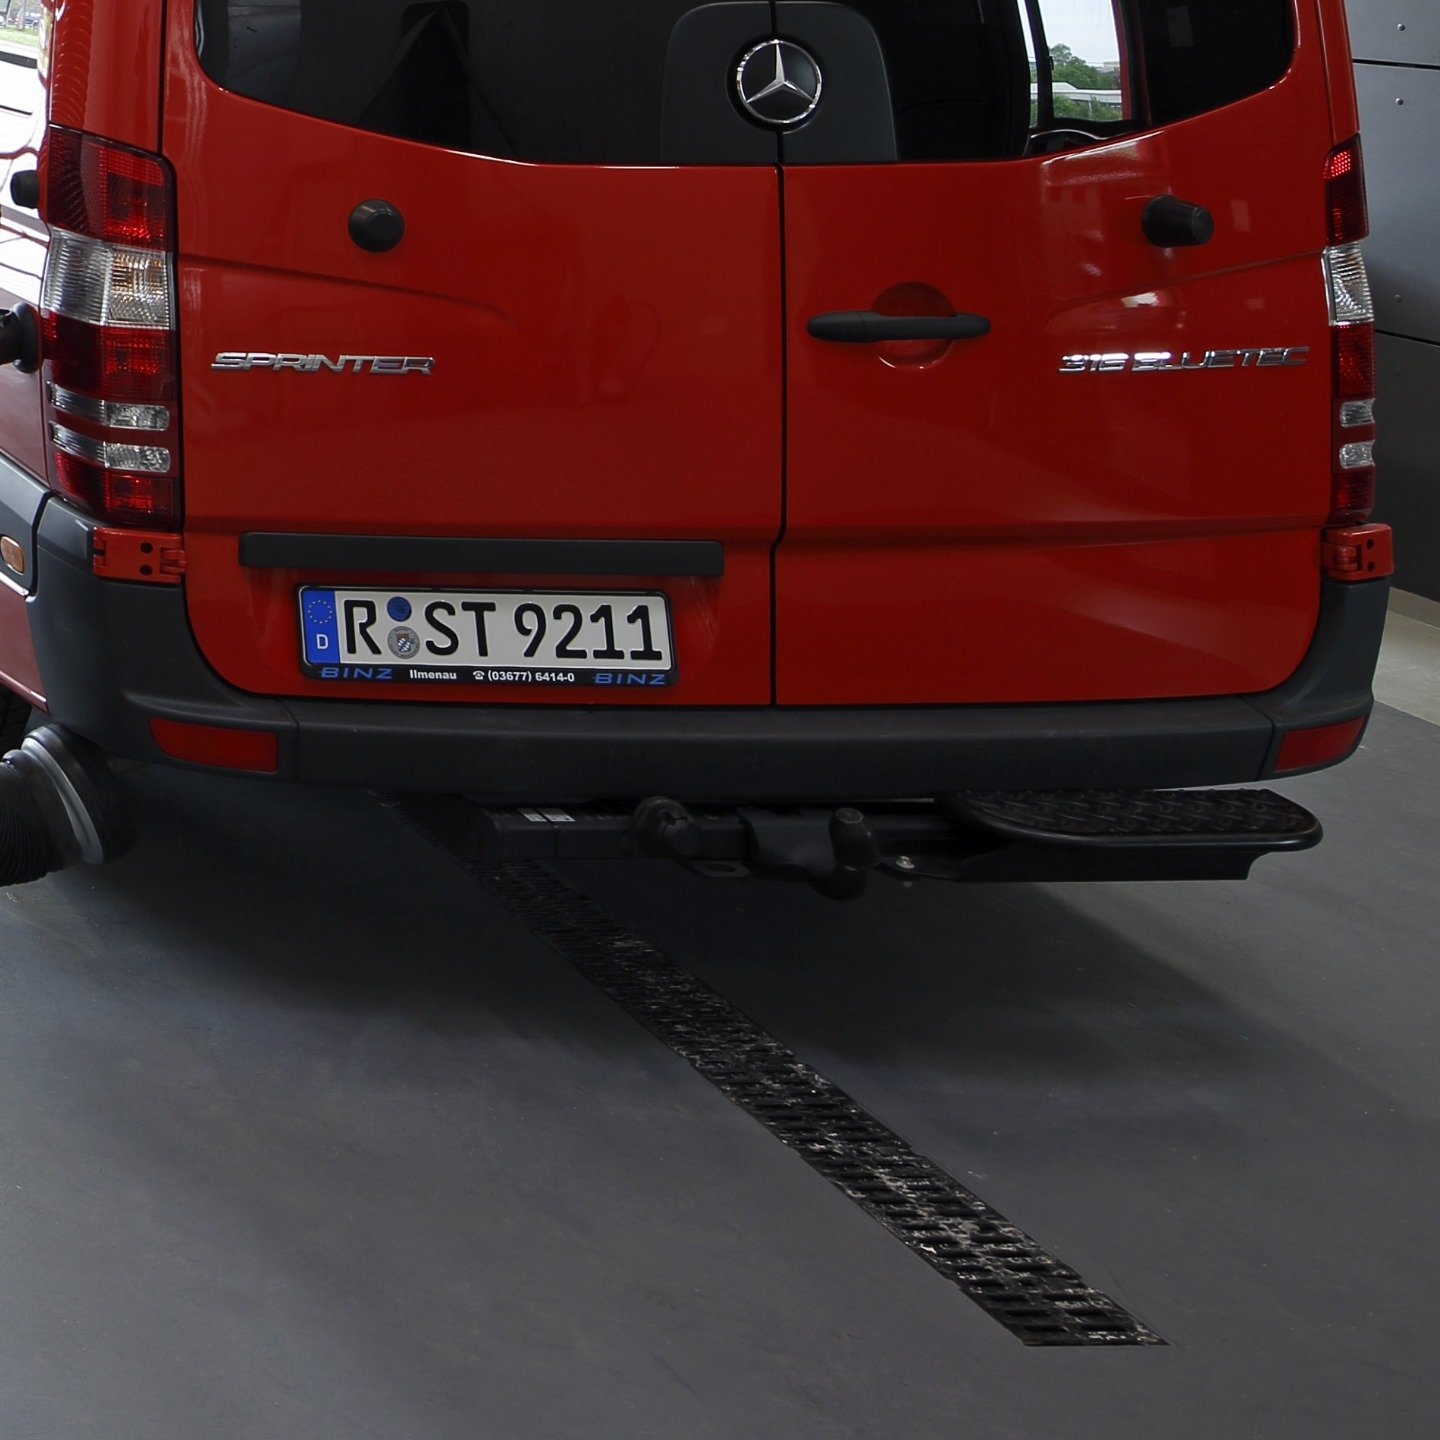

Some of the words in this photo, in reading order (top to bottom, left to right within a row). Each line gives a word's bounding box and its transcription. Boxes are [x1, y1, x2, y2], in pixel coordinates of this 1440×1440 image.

[211, 352, 435, 375] SPRINTER
[343, 599, 381, 655] R
[424, 601, 496, 657] ST
[514, 602, 662, 661] 9211
[316, 634, 329, 650] D
[319, 667, 392, 679] BINZ
[409, 669, 457, 680] Ilmenau
[487, 670, 532, 682] (03677)
[535, 672, 575, 682] 6414-0
[594, 673, 666, 685] BINZ
